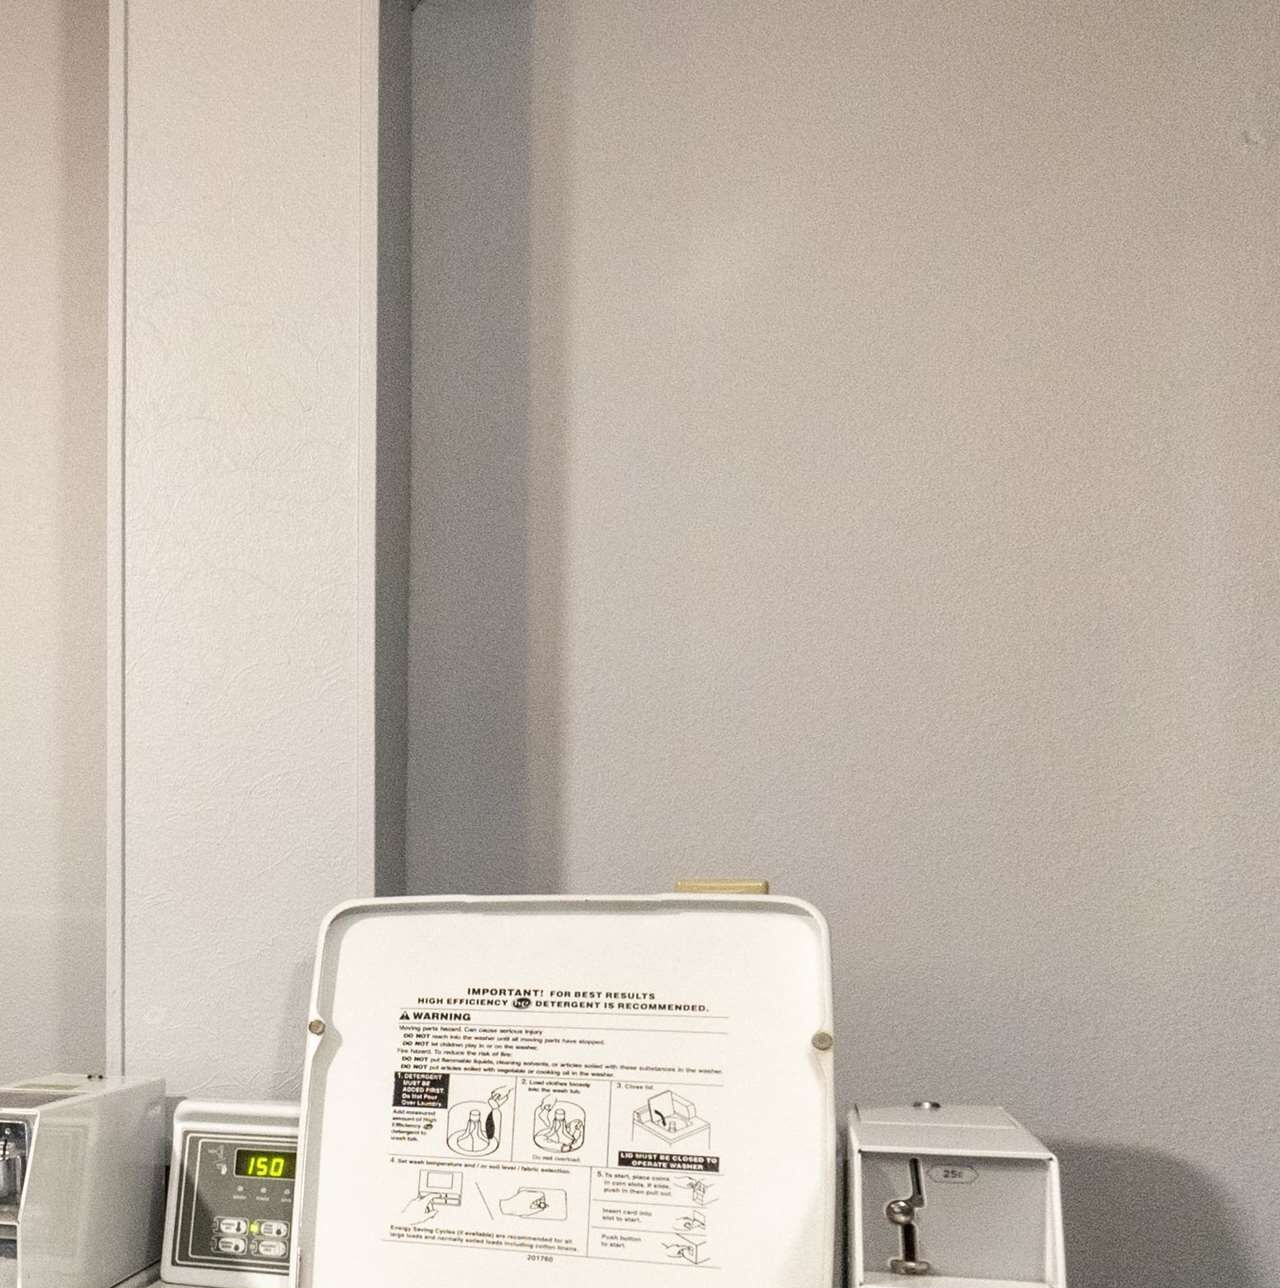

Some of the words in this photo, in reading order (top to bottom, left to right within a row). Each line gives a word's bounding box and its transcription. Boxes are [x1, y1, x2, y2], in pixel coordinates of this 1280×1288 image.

[467, 988, 544, 997] IMPORTANT!
[550, 990, 571, 998] FOR
[574, 991, 602, 999] BEST
[605, 992, 655, 1000] RESULTS
[417, 997, 444, 1005] HIGH
[446, 998, 508, 1006] EFFICIENCY
[535, 1000, 601, 1009] DETERGENT
[617, 1002, 709, 1012] RECOMMENDED.
[412, 1012, 471, 1021] WARNING
[635, 1153, 658, 1161] MUST
[660, 1154, 670, 1162] BE
[672, 1155, 705, 1164] CLOSED
[247, 1156, 285, 1177] 150
[631, 1160, 667, 1168] OPERATE
[669, 1162, 704, 1170] WASHER
